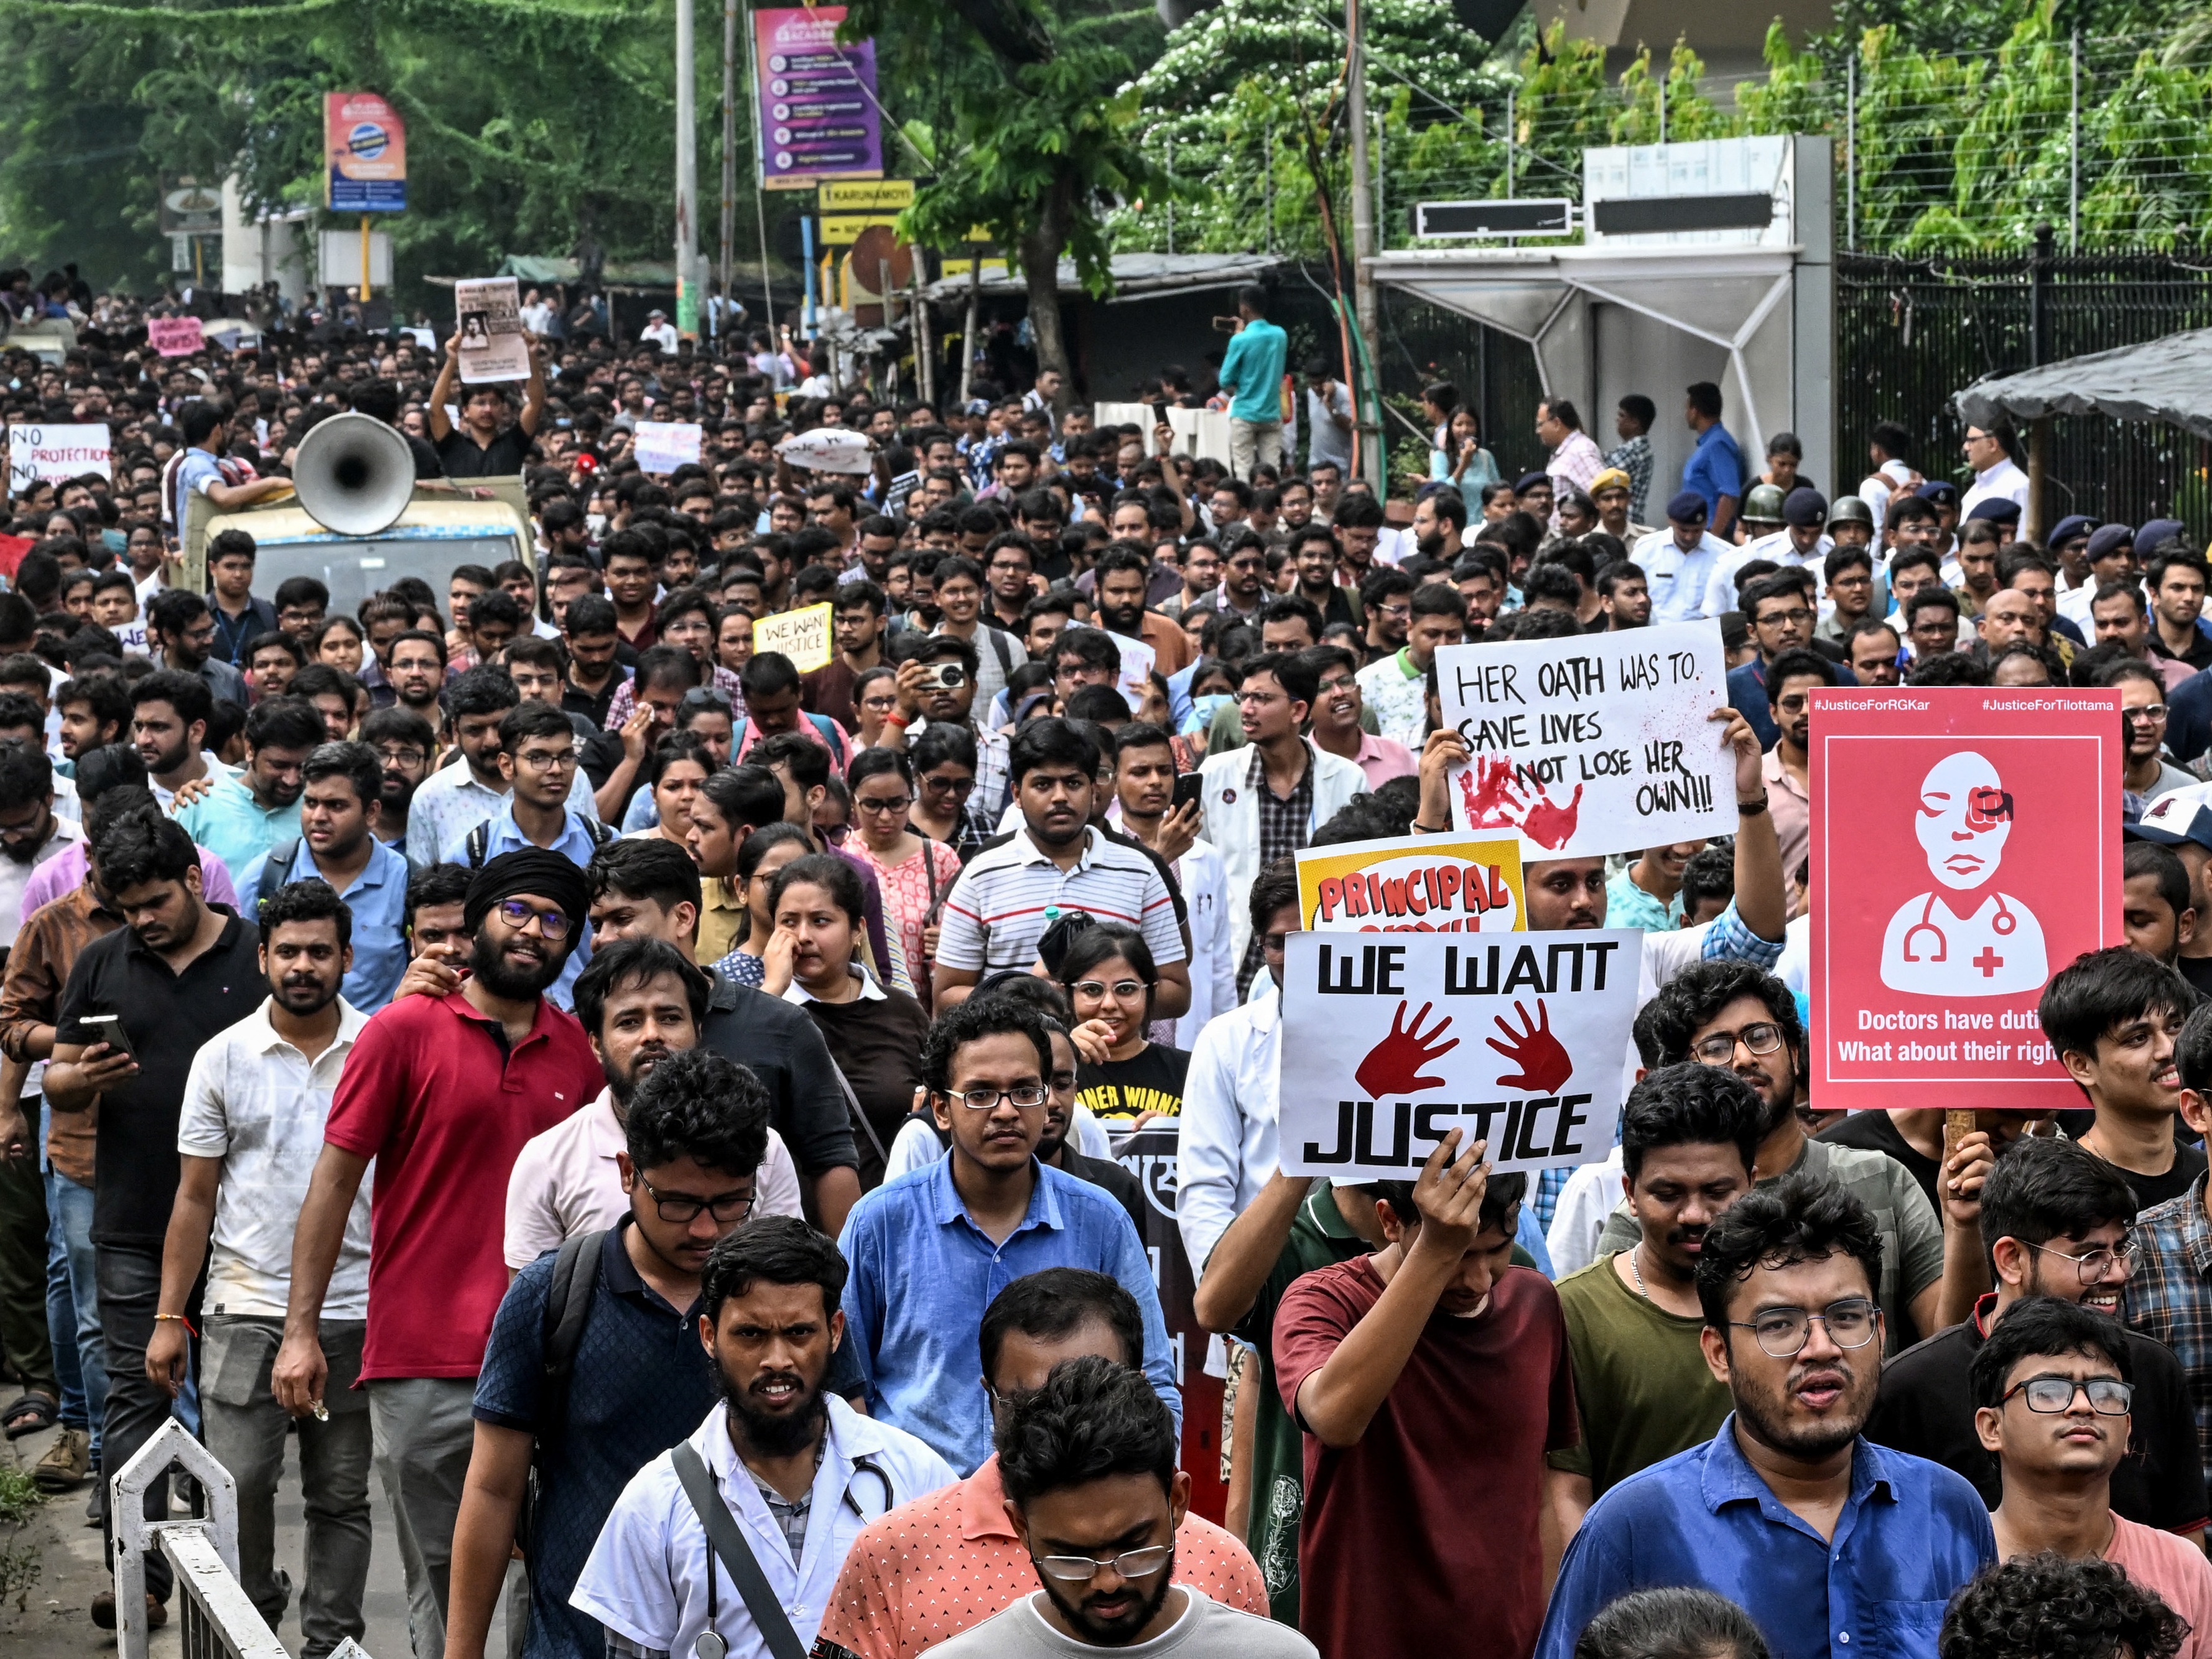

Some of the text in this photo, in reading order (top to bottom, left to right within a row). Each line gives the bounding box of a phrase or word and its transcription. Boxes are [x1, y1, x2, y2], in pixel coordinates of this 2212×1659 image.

[12, 427, 42, 446] NO
[12, 462, 37, 480] NO
[116, 628, 147, 646] WE
[766, 613, 825, 641] WE WANT
[1457, 664, 1526, 707] HER
[1538, 657, 1605, 702] OATH
[1620, 653, 1659, 691] WAS
[1815, 699, 2114, 711] #JusticeForRGKar #JusticeForTilottama
[1457, 711, 1602, 754] SAVE LIVES
[1516, 740, 1691, 791] NOT LOSE HER
[1636, 774, 1714, 816] OWN!!!
[1318, 864, 1509, 923] PRINCIPAL
[1317, 941, 1619, 995] WE WANT
[1858, 1009, 2041, 1030] Doctors have duti
[1838, 1041, 2057, 1065] What about their righ
[1075, 1085, 1182, 1117] NNER WINNE
[1303, 1092, 1592, 1168] JUSTICE
